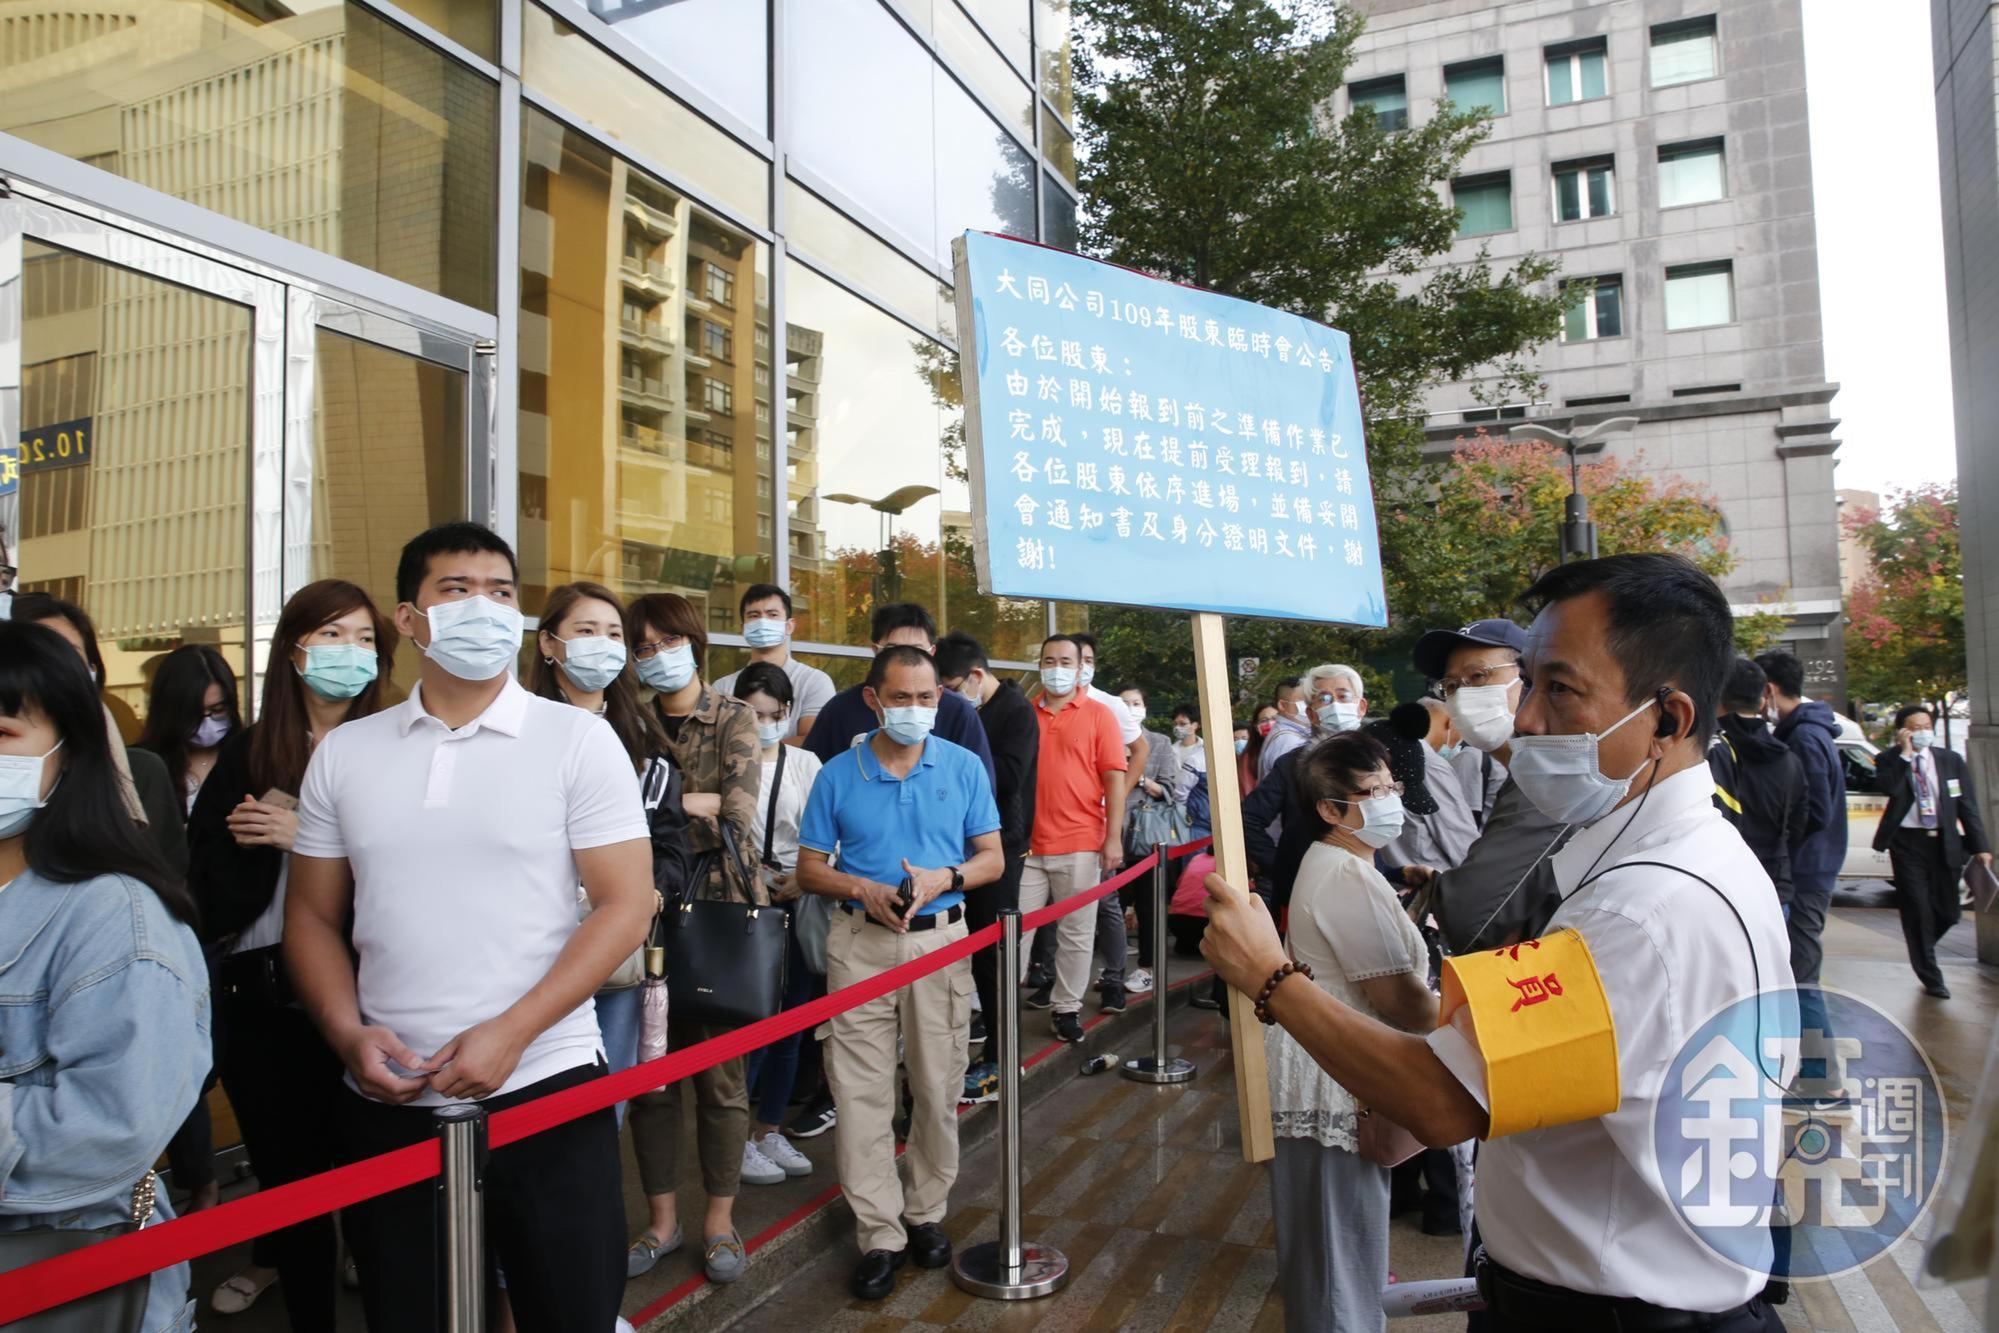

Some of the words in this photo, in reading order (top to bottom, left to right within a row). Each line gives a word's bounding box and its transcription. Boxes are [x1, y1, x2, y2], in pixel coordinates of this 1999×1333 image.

[995, 268, 1334, 373] 大同公司109年股東臨時會公告
[1000, 326, 1133, 376] 各位股東：
[1006, 368, 1349, 459] 由於開始報到前之準備作業已
[1008, 408, 1353, 496] 完成，現在提前受理報到，請
[1010, 450, 1359, 531] 各位股東依序進場，並備妥開
[1013, 493, 1364, 566] 會通知書及身分證明文件，謝
